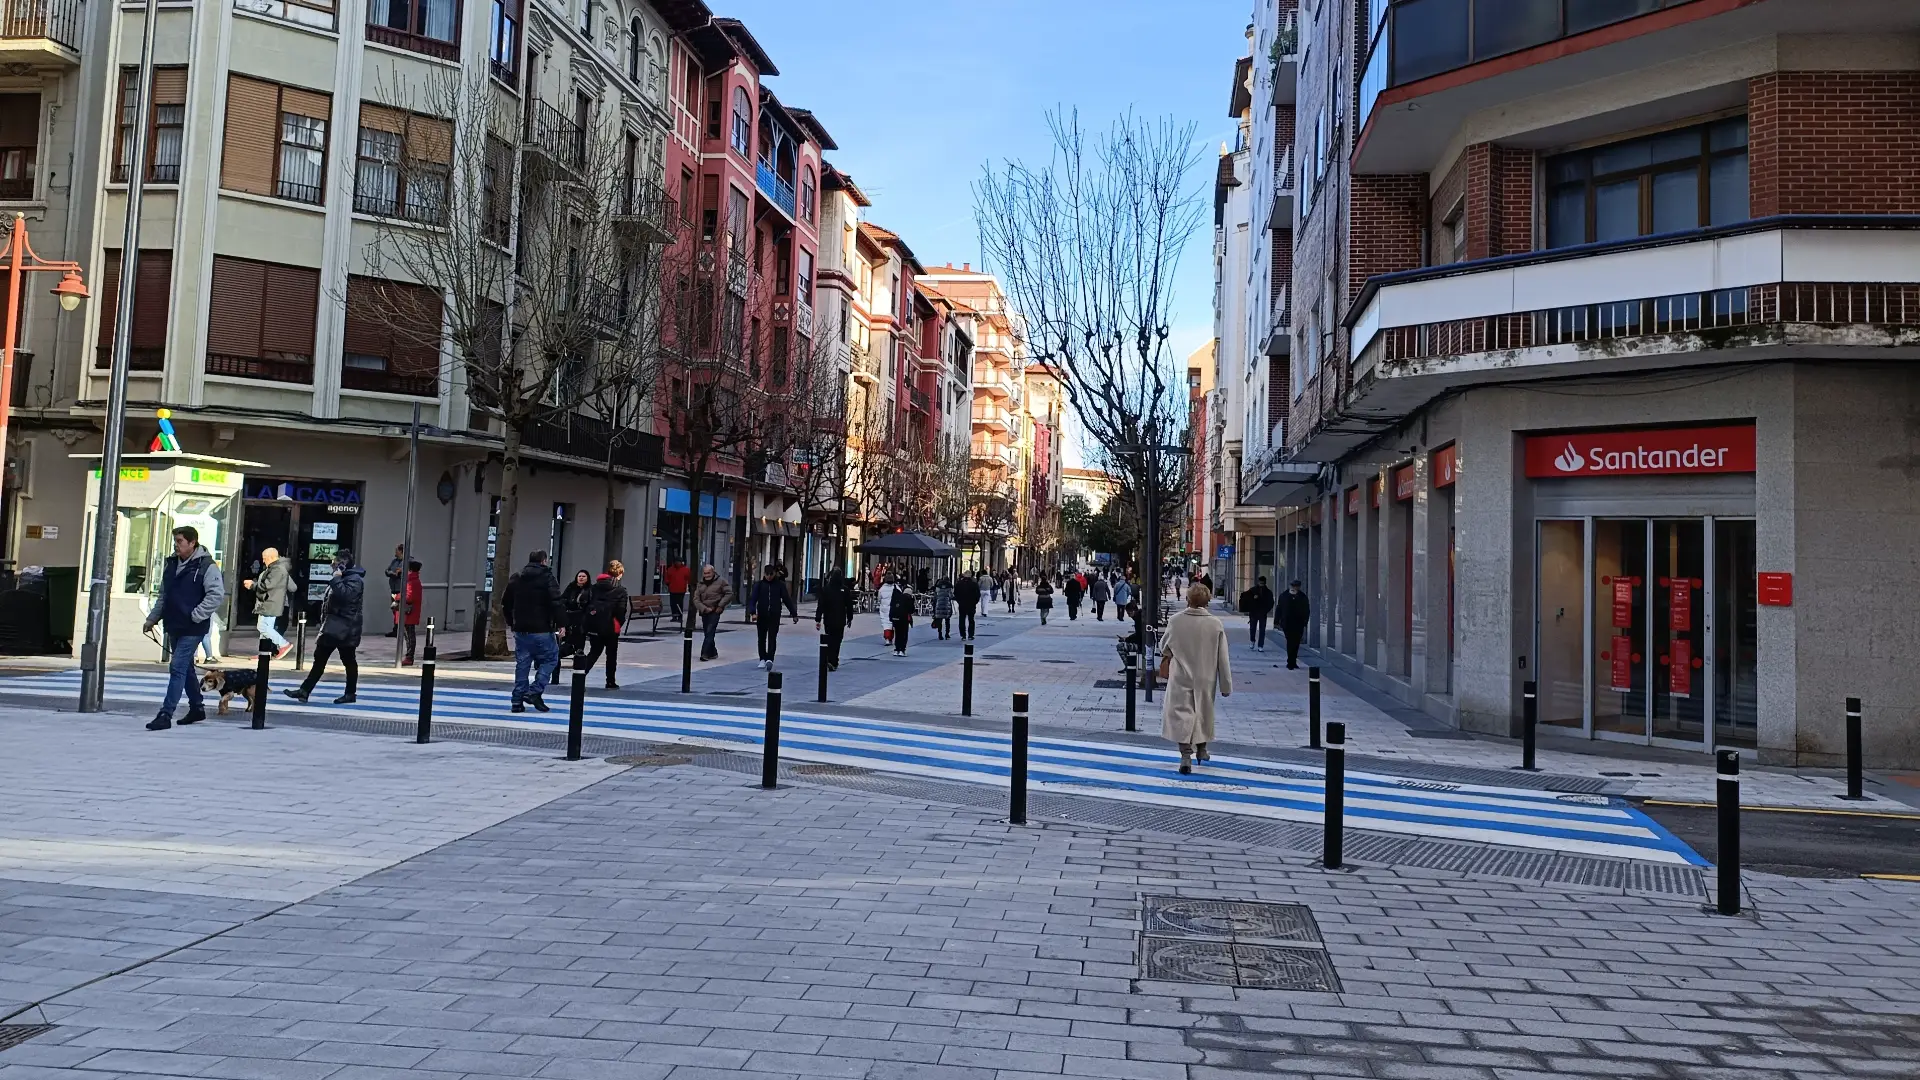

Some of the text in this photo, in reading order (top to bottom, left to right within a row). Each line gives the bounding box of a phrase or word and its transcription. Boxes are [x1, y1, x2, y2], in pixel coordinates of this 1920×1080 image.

[1589, 443, 1729, 471] Santander
[120, 468, 145, 478] NCE
[202, 472, 226, 483] ONCE
[244, 484, 361, 505] LA CASA
[327, 504, 360, 514] agency
